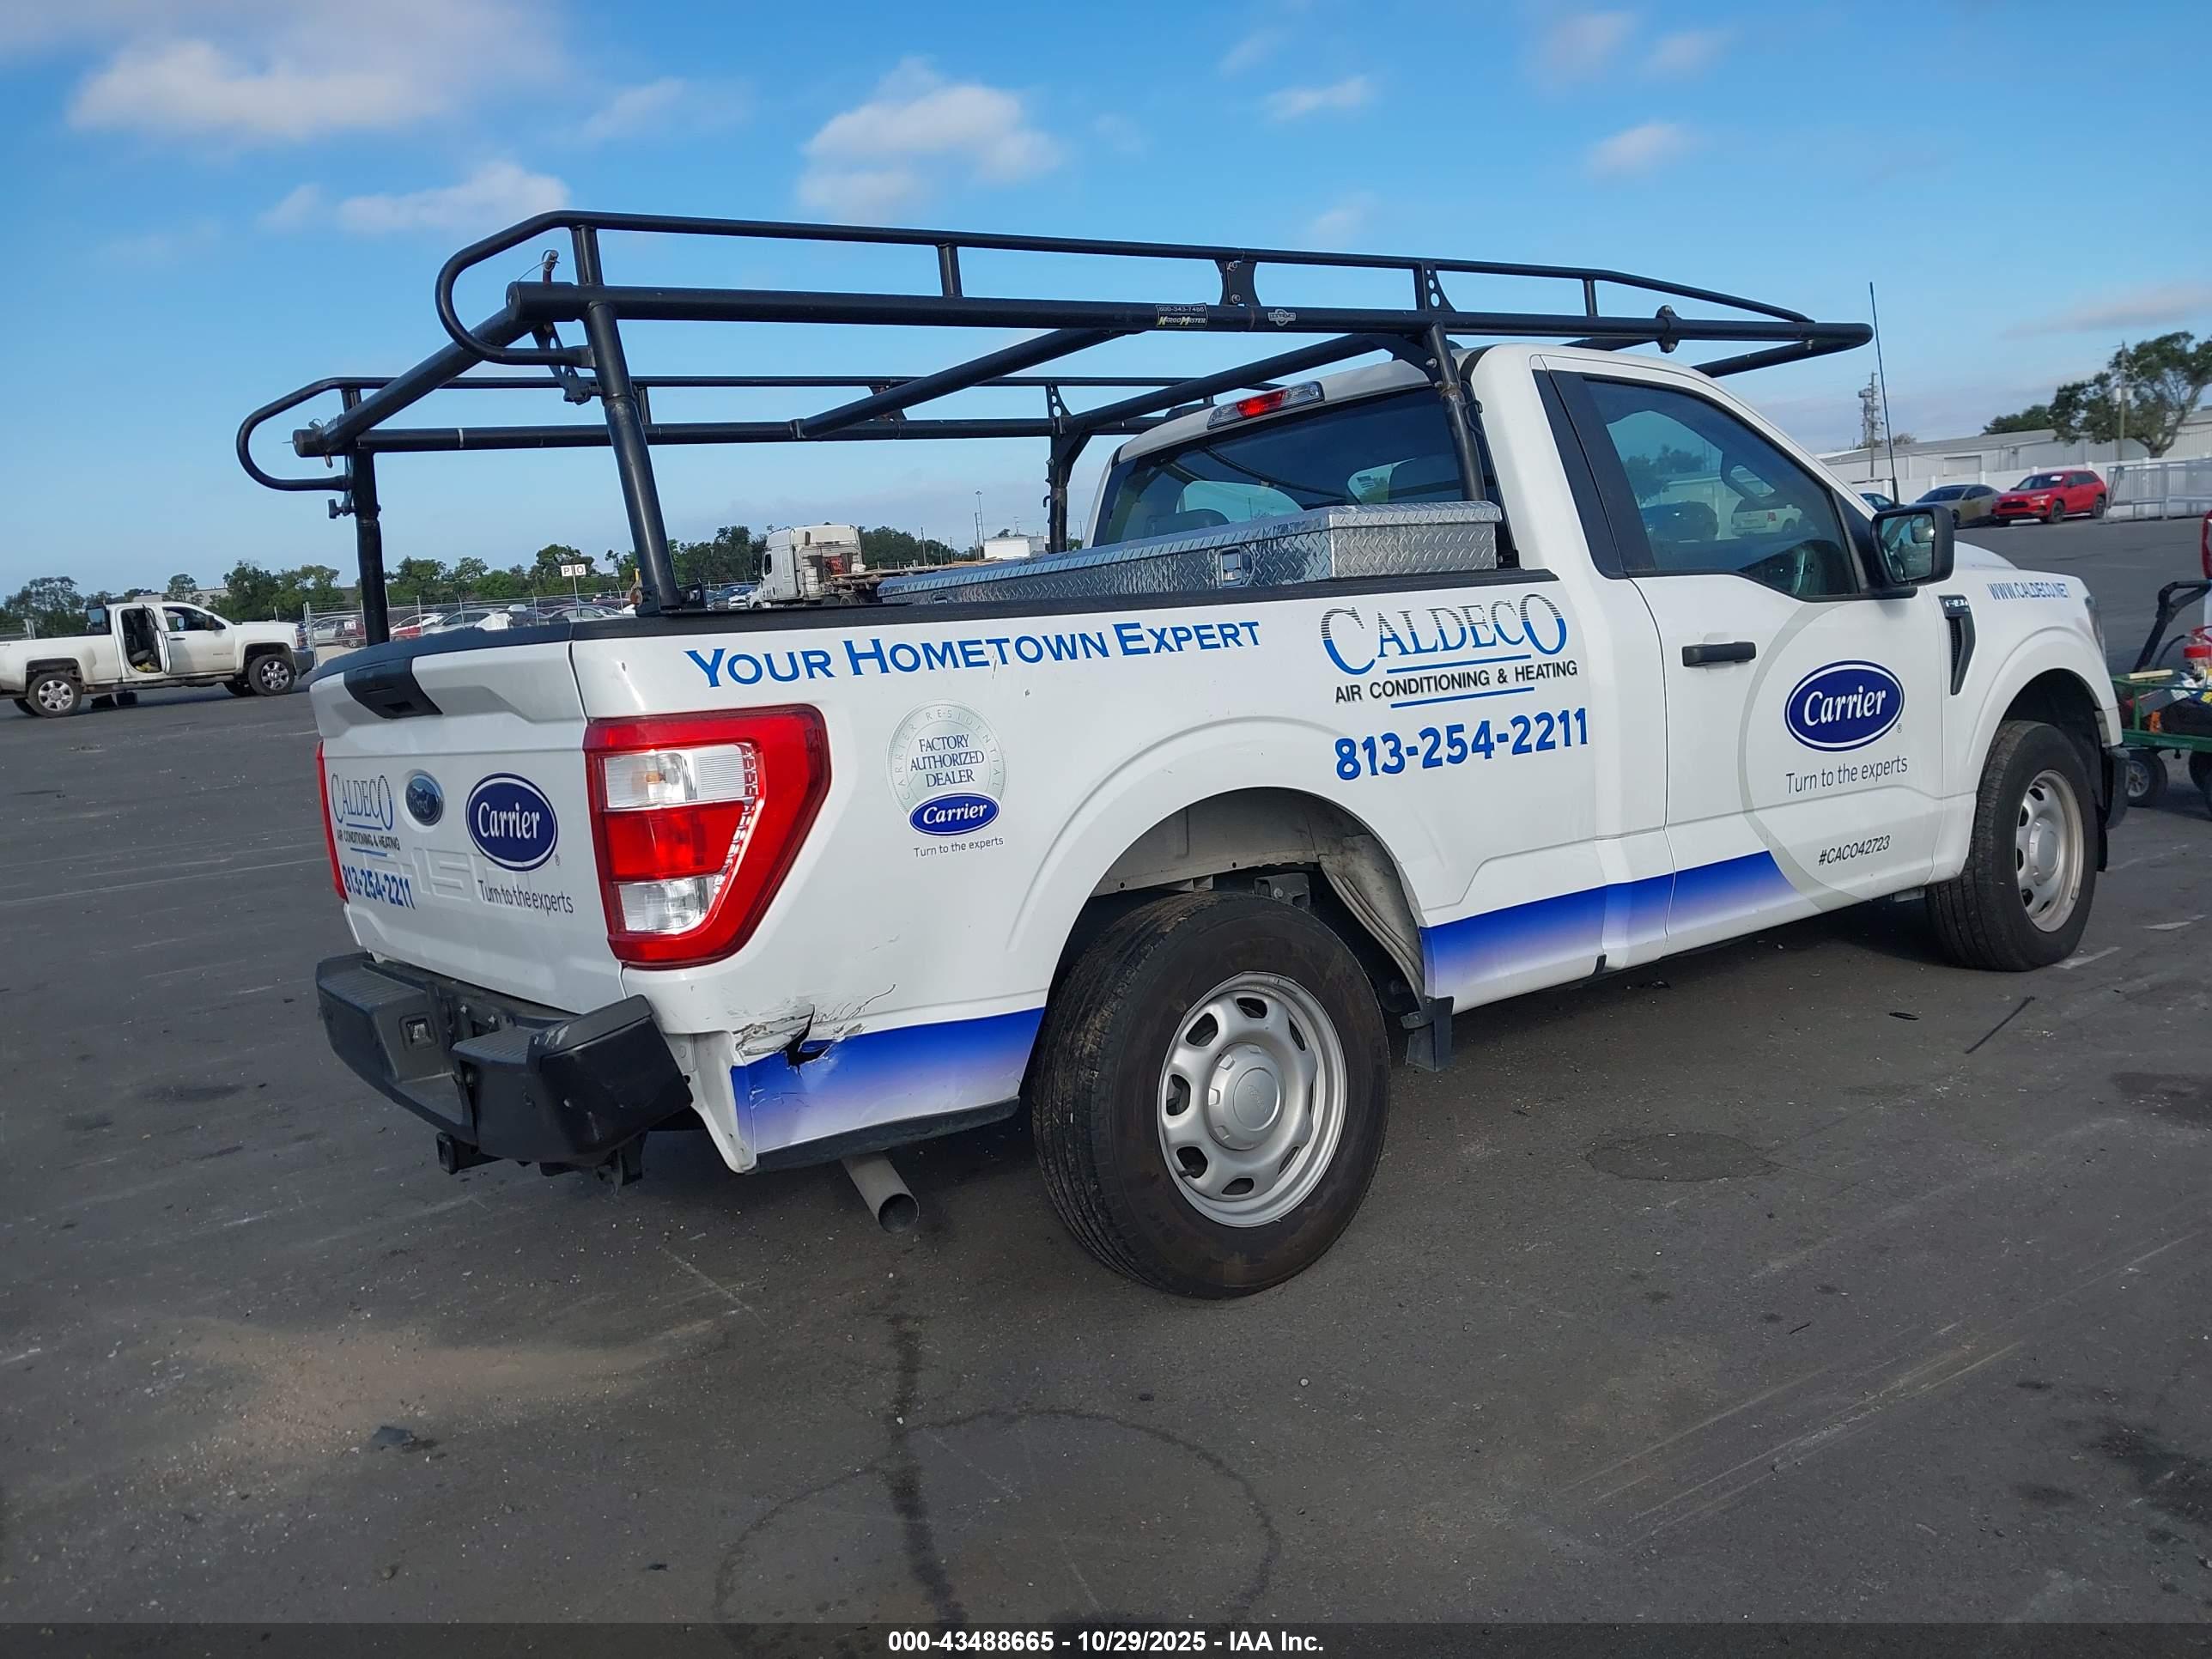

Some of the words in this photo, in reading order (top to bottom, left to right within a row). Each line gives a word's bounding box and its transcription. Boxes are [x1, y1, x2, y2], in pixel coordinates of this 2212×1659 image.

[1986, 582, 2071, 600] WWW.CALDECO.NET
[1320, 593, 1567, 675] CALDECO
[684, 647, 837, 688] YOUR
[842, 632, 1111, 677] HOMETOWN
[1111, 621, 1261, 657] EXPERT
[1335, 684, 1363, 703] AIR
[1370, 670, 1490, 699] CONDITIONING
[1497, 668, 1509, 684] &
[1515, 659, 1578, 683] HEATING
[1803, 685, 1887, 726] Carrier
[910, 750, 985, 771] AUTHORIZED
[919, 734, 969, 752] FACTORY
[1334, 708, 1589, 781] 813-254-2211
[926, 769, 975, 787] DEALER
[1786, 772, 1817, 794] Turn
[1821, 769, 1834, 787] to
[1838, 763, 1857, 785] the
[1862, 755, 1908, 783] experts
[331, 774, 393, 831] CALDECO
[477, 801, 540, 839] Carrier
[922, 803, 988, 824] Carrier
[343, 830, 374, 848] CONDITIONING
[379, 836, 401, 851] HEATING
[914, 847, 937, 858] Turn
[939, 844, 949, 854] to
[951, 842, 966, 853] the
[969, 836, 1004, 850] experts
[343, 864, 416, 910] 813-254-2211
[477, 879, 502, 904] Turn
[500, 884, 514, 905] to
[513, 884, 532, 908] the
[532, 890, 574, 917] experts
